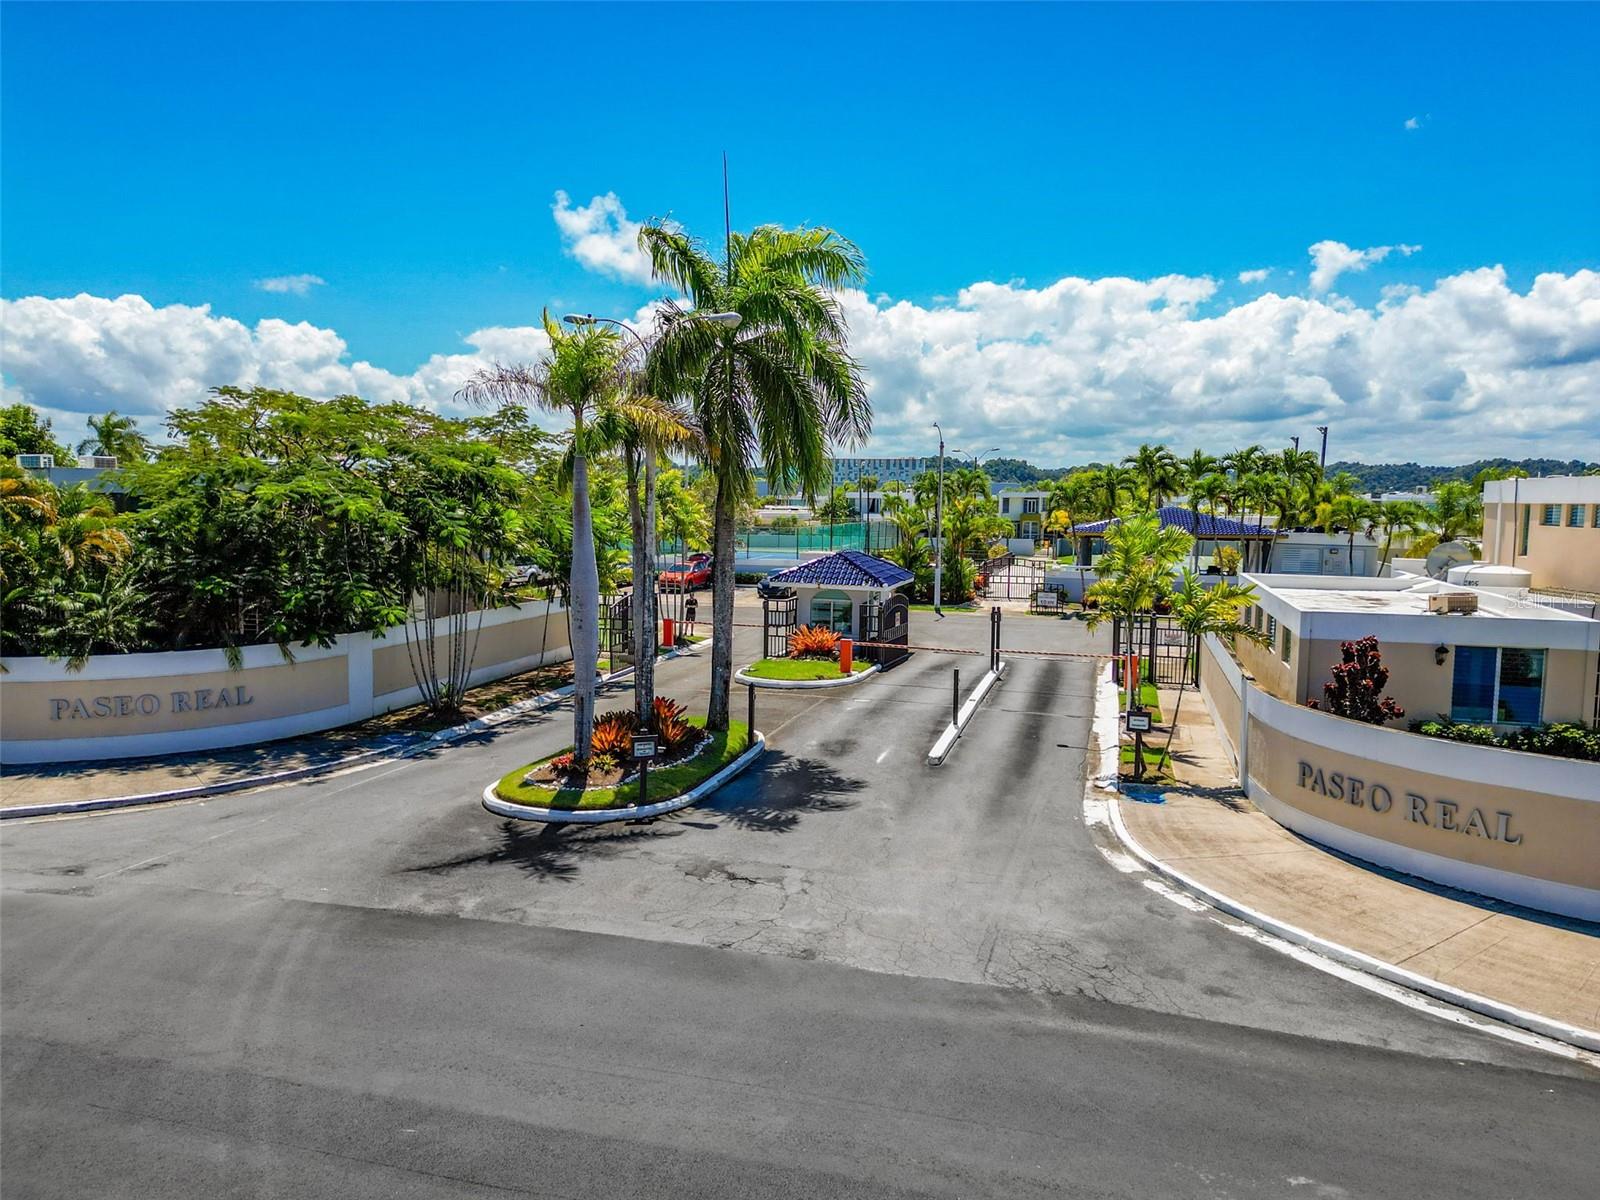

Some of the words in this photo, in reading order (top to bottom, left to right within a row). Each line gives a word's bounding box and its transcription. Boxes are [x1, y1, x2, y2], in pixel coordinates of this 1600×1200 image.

[49, 693, 161, 721] PASEO
[170, 685, 255, 713] REAL
[1297, 761, 1393, 813] PASEO
[1404, 792, 1524, 846] REAL
